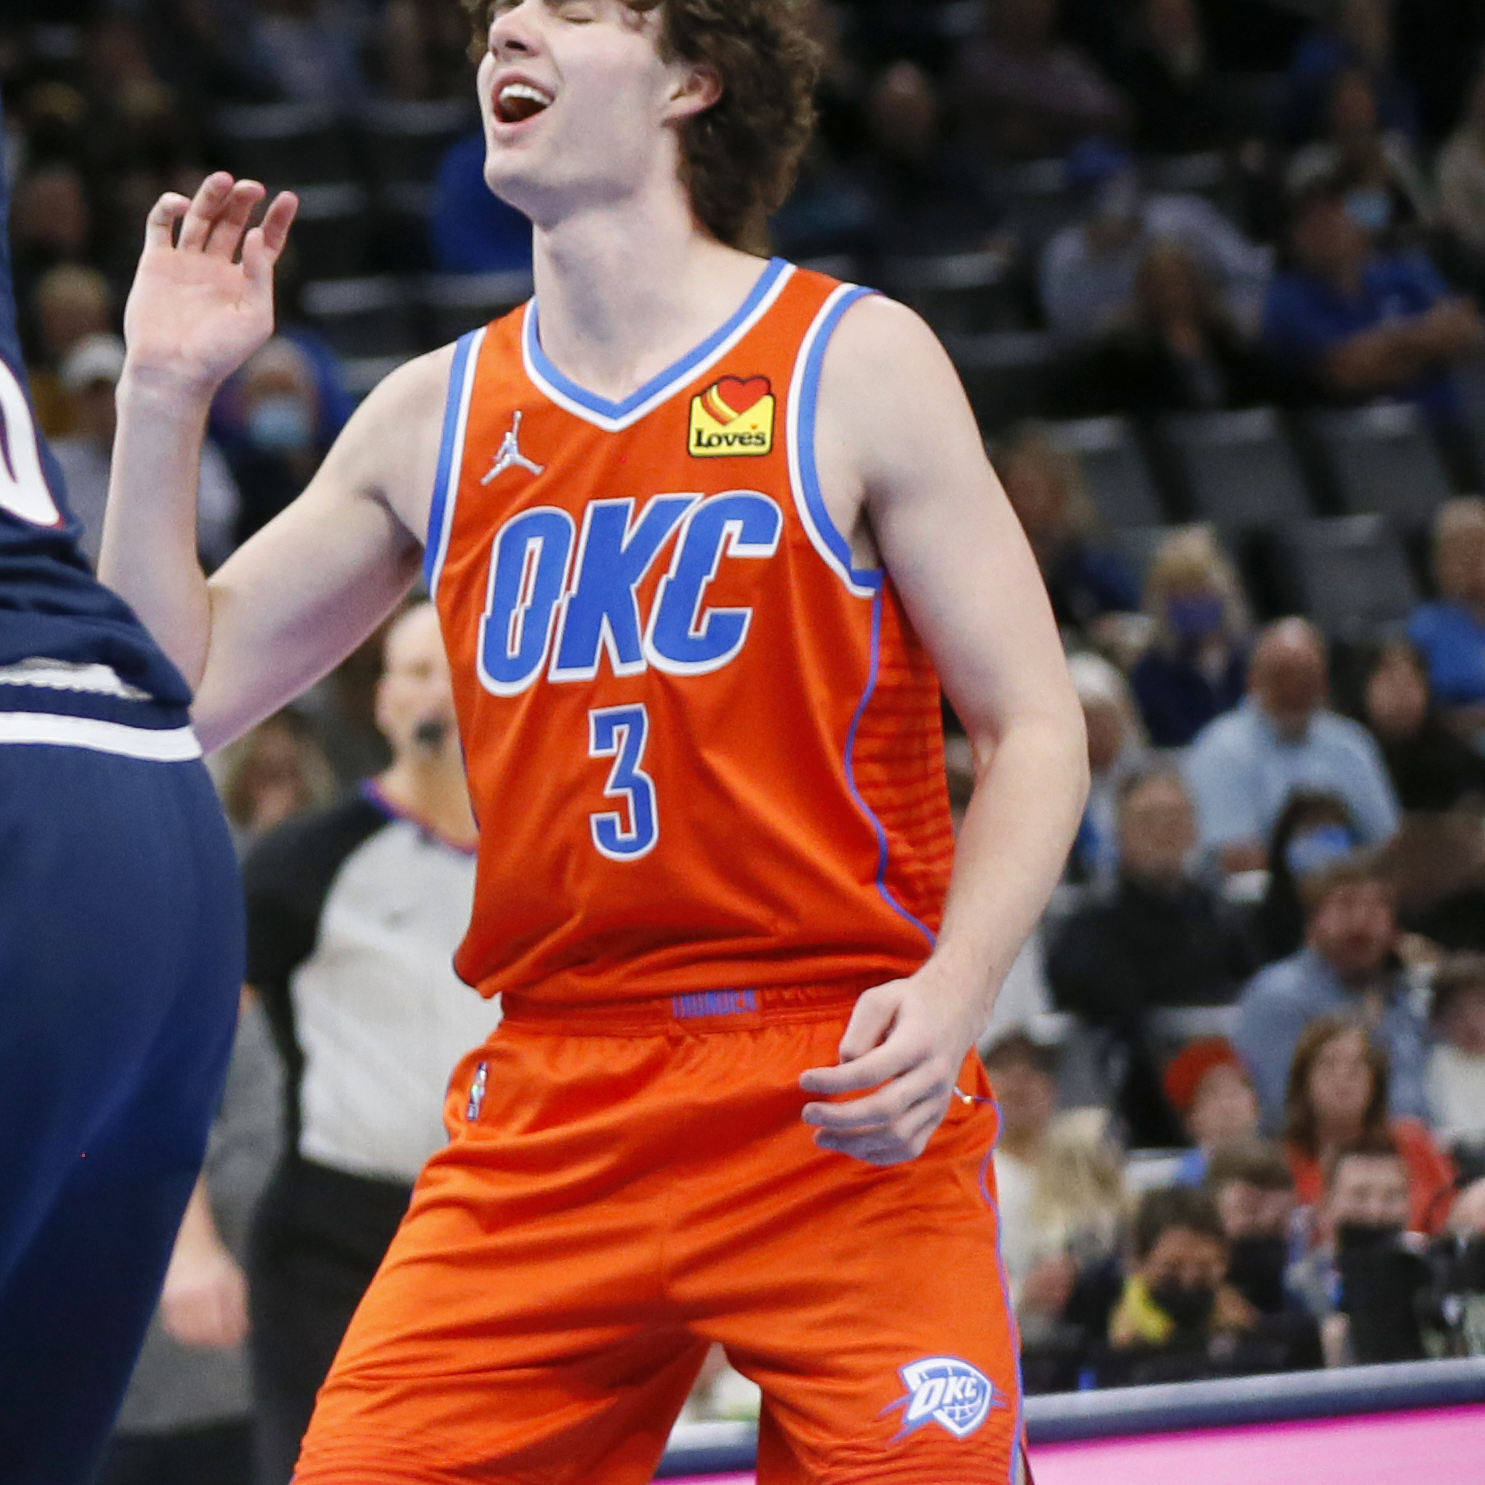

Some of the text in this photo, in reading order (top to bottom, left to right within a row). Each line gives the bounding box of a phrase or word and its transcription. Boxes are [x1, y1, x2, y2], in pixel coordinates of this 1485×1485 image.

[476, 489, 784, 698] OKC
[587, 702, 660, 862] 3
[907, 1375, 979, 1420] OKC
